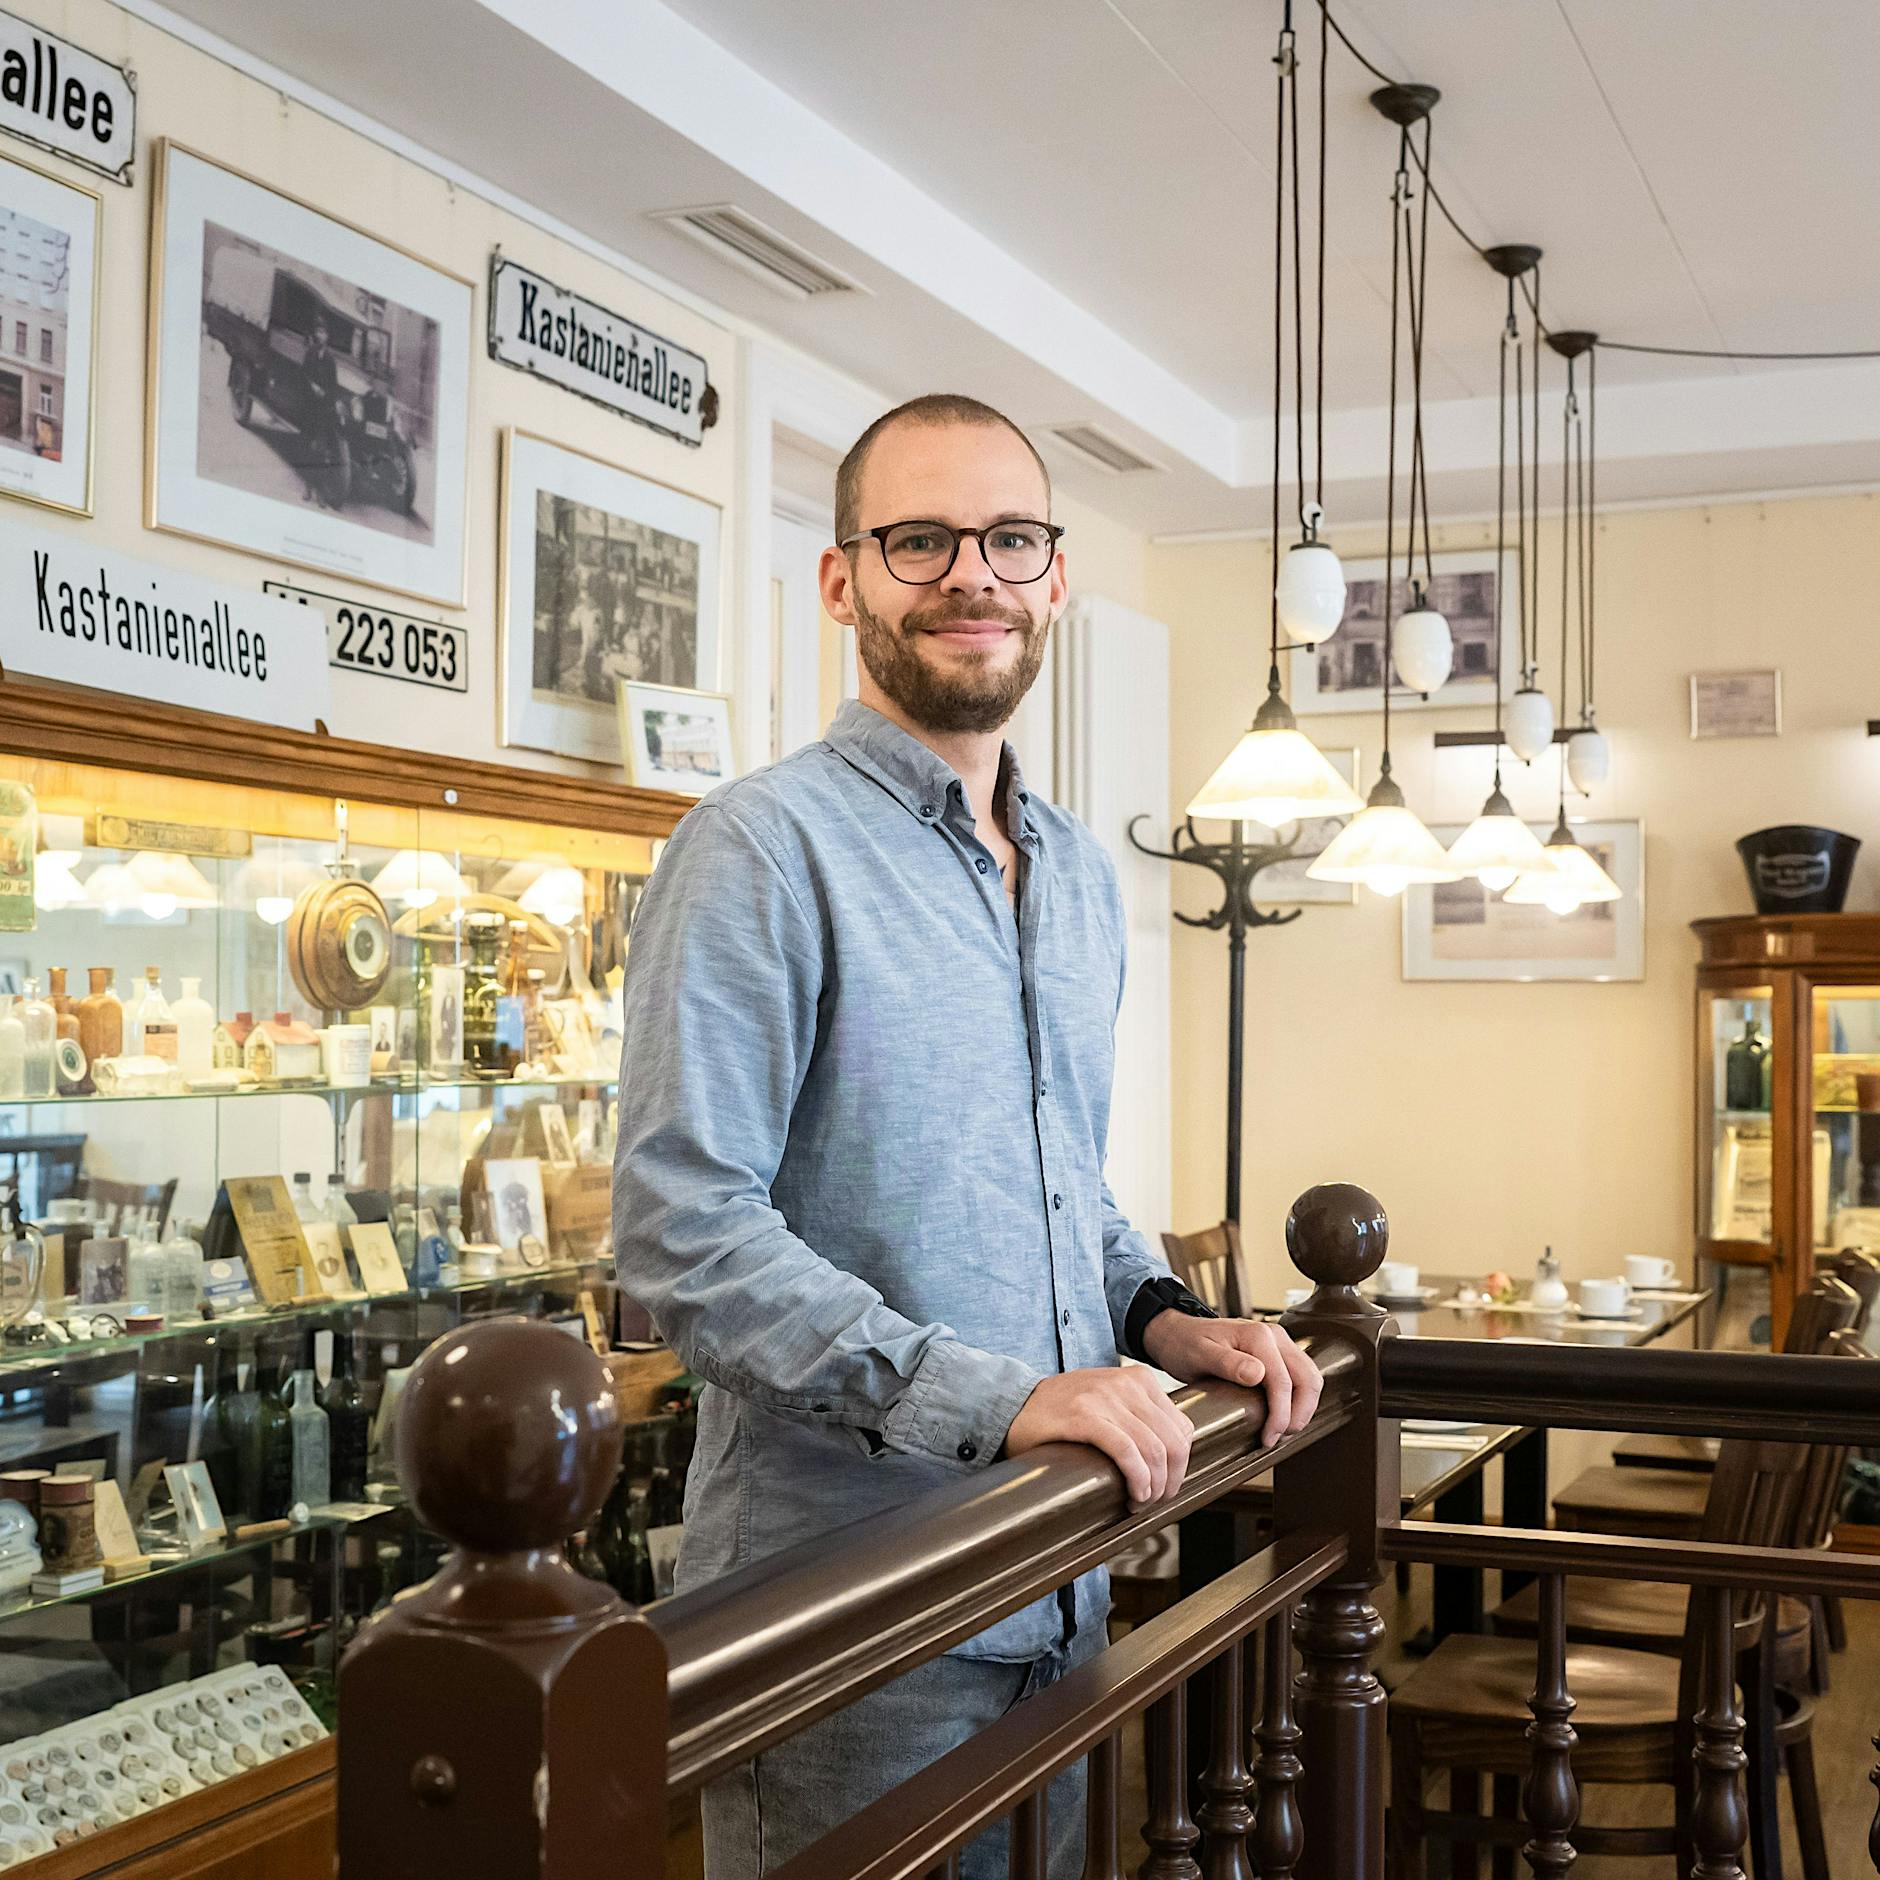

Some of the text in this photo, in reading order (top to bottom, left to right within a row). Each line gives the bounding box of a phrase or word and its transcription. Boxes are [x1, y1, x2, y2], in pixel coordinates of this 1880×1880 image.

[2, 37, 113, 143] allee
[518, 279, 693, 415] Kastanienallee
[34, 550, 267, 682] Kastanienallee
[337, 607, 456, 681] 223 053
